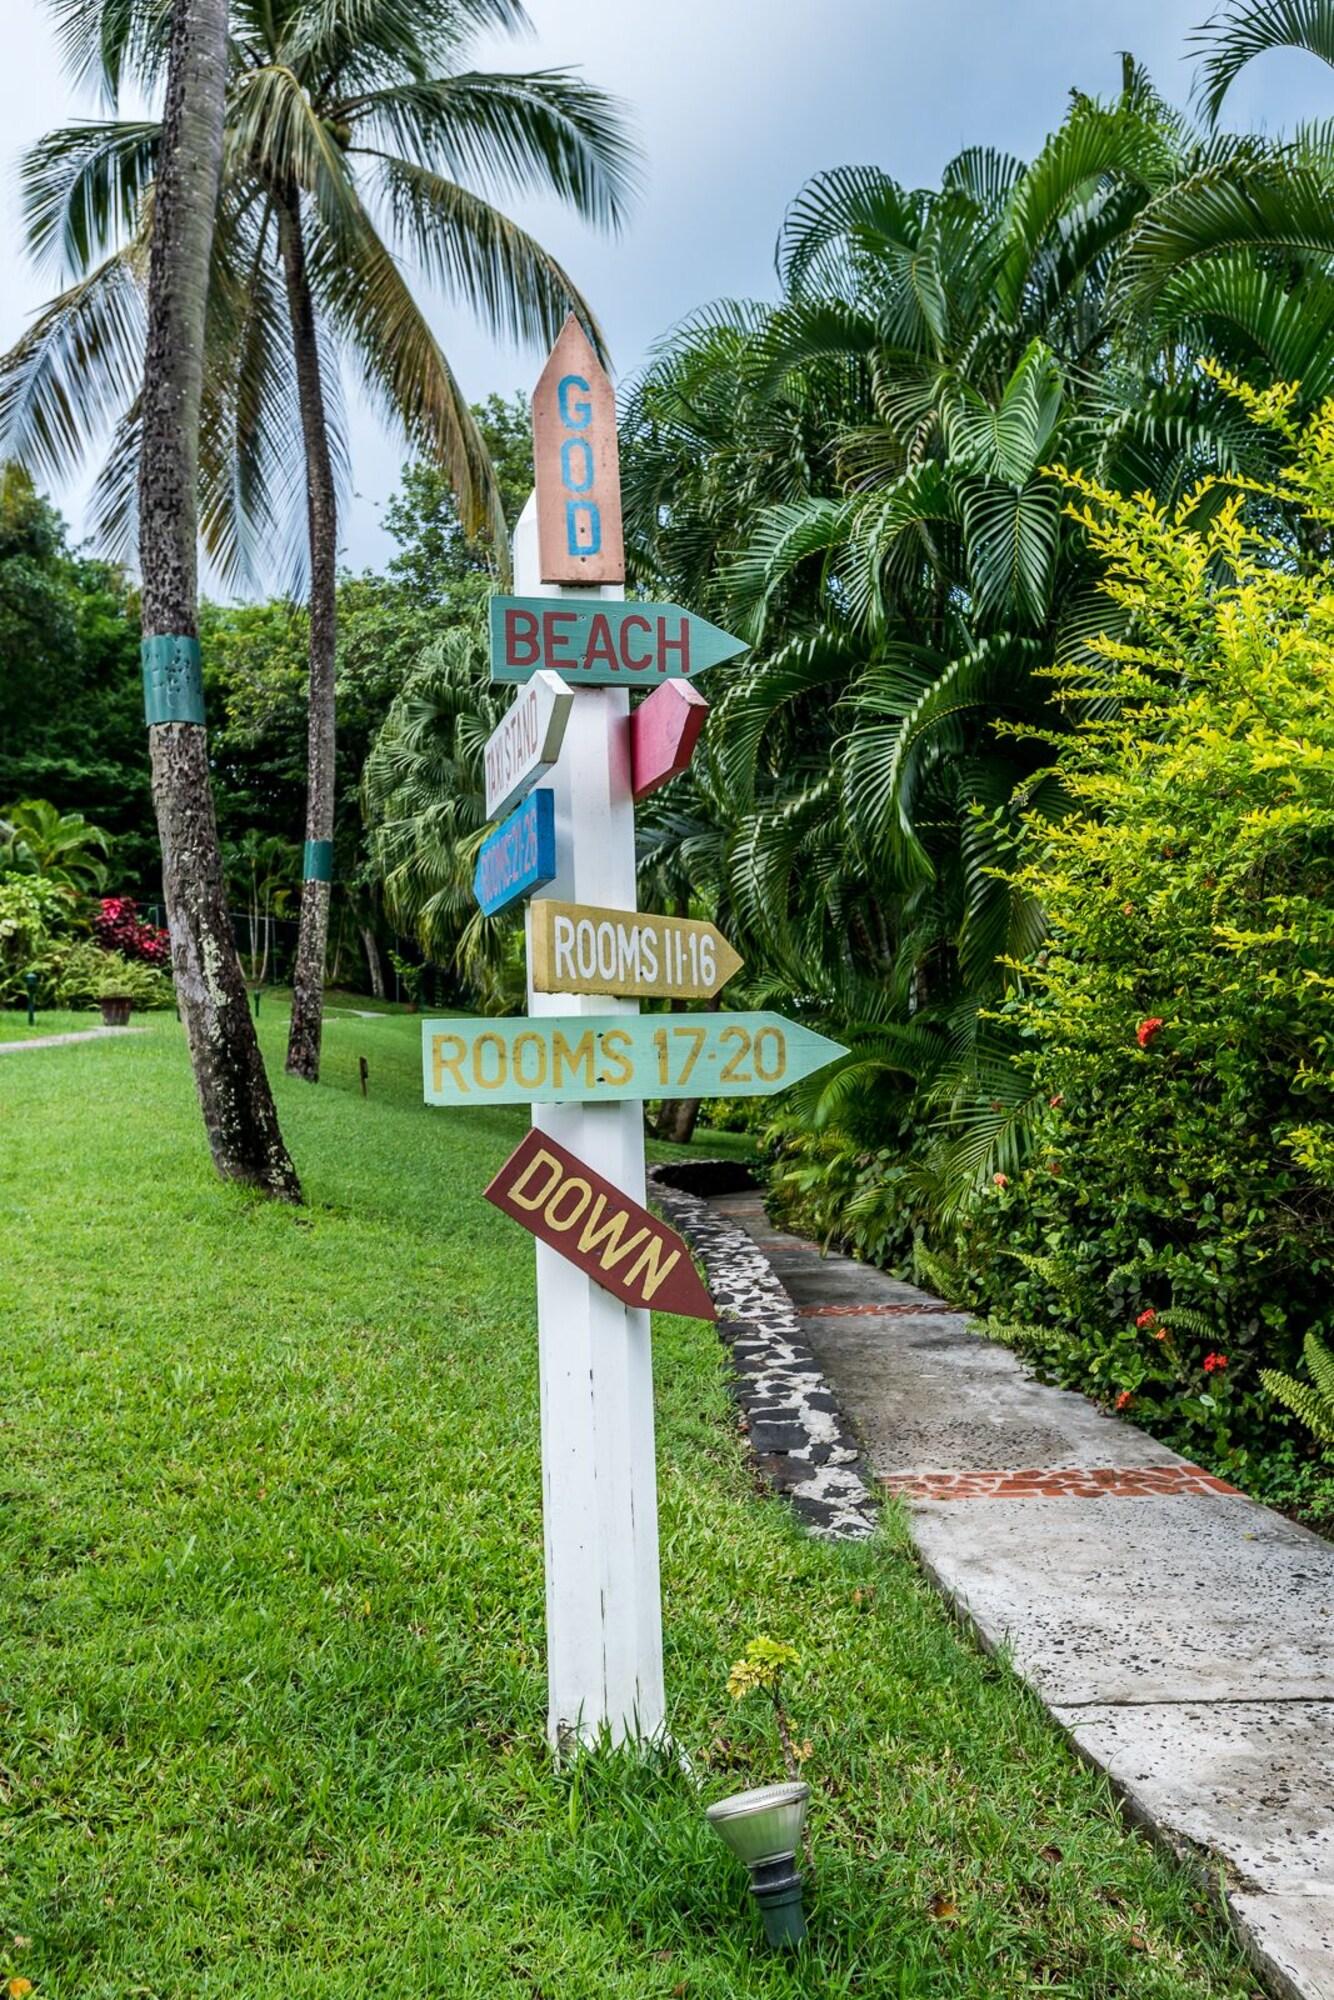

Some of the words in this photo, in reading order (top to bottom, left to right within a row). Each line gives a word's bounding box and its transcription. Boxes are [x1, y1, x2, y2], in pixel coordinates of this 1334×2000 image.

[558, 375, 601, 556] GOD
[504, 609, 691, 673] BEACH
[486, 736, 504, 802] TAXI
[504, 690, 538, 781] STAND
[554, 915, 659, 984] ROOMS
[432, 1030, 634, 1092] ROOMS
[506, 1148, 682, 1302] DOWN
